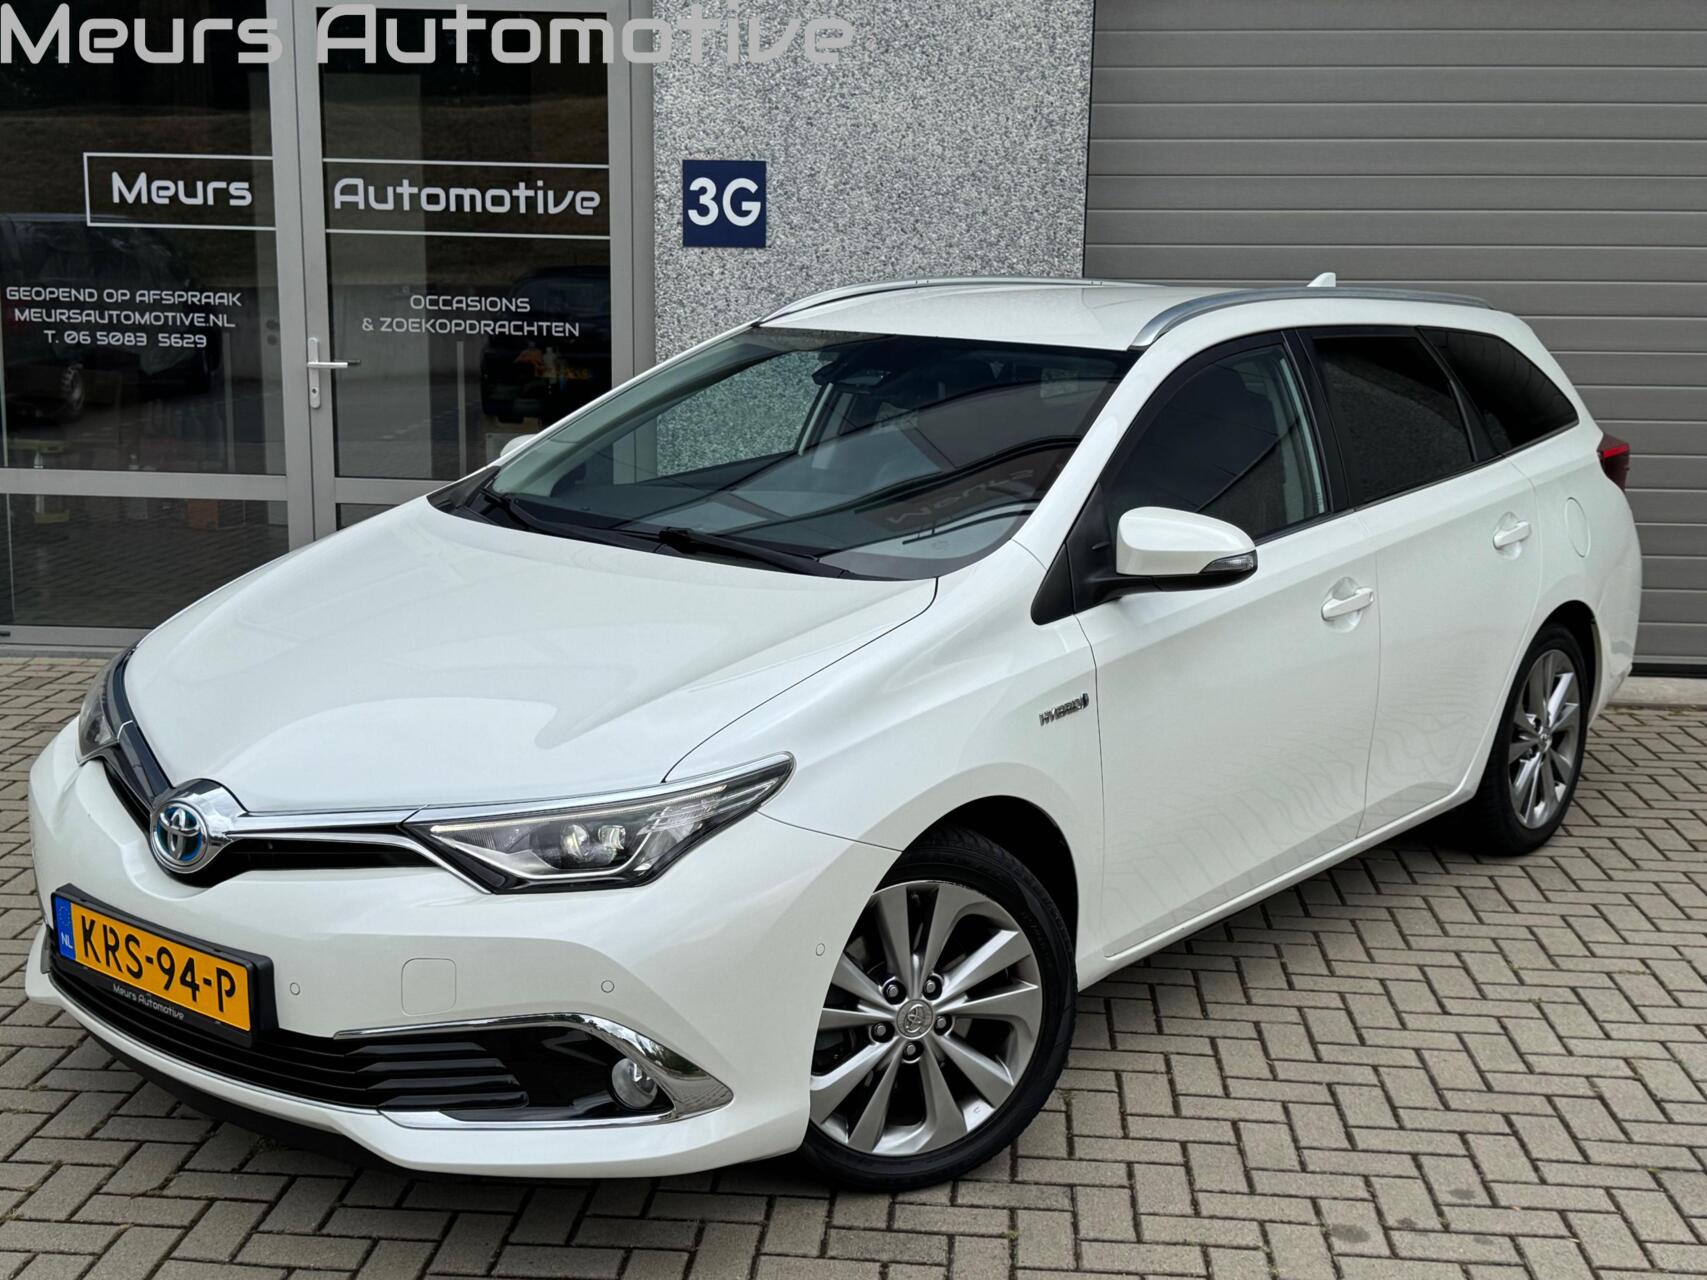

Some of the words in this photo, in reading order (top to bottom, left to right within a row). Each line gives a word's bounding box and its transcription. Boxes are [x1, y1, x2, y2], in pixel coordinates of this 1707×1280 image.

[111, 171, 253, 206] Meurs
[334, 178, 600, 215] Automotive
[687, 177, 761, 226] 3G
[6, 287, 97, 302] GEOPEND
[103, 289, 130, 303] OP
[136, 290, 242, 306] AFSPRAAK
[410, 295, 530, 312] OCCASIONS
[14, 308, 236, 328] MEURSAUTOMOTIVE.NL
[362, 318, 374, 331] &
[380, 318, 579, 337] ZOEKOPDRACHTEN
[44, 330, 60, 344] T.
[64, 330, 91, 344] 06
[96, 332, 147, 346] 5083
[158, 333, 207, 348] 5629
[61, 932, 73, 949] NL
[80, 915, 236, 1013] KRS-94-P
[113, 983, 137, 1001] Meurs
[138, 995, 185, 1020] Automotive
